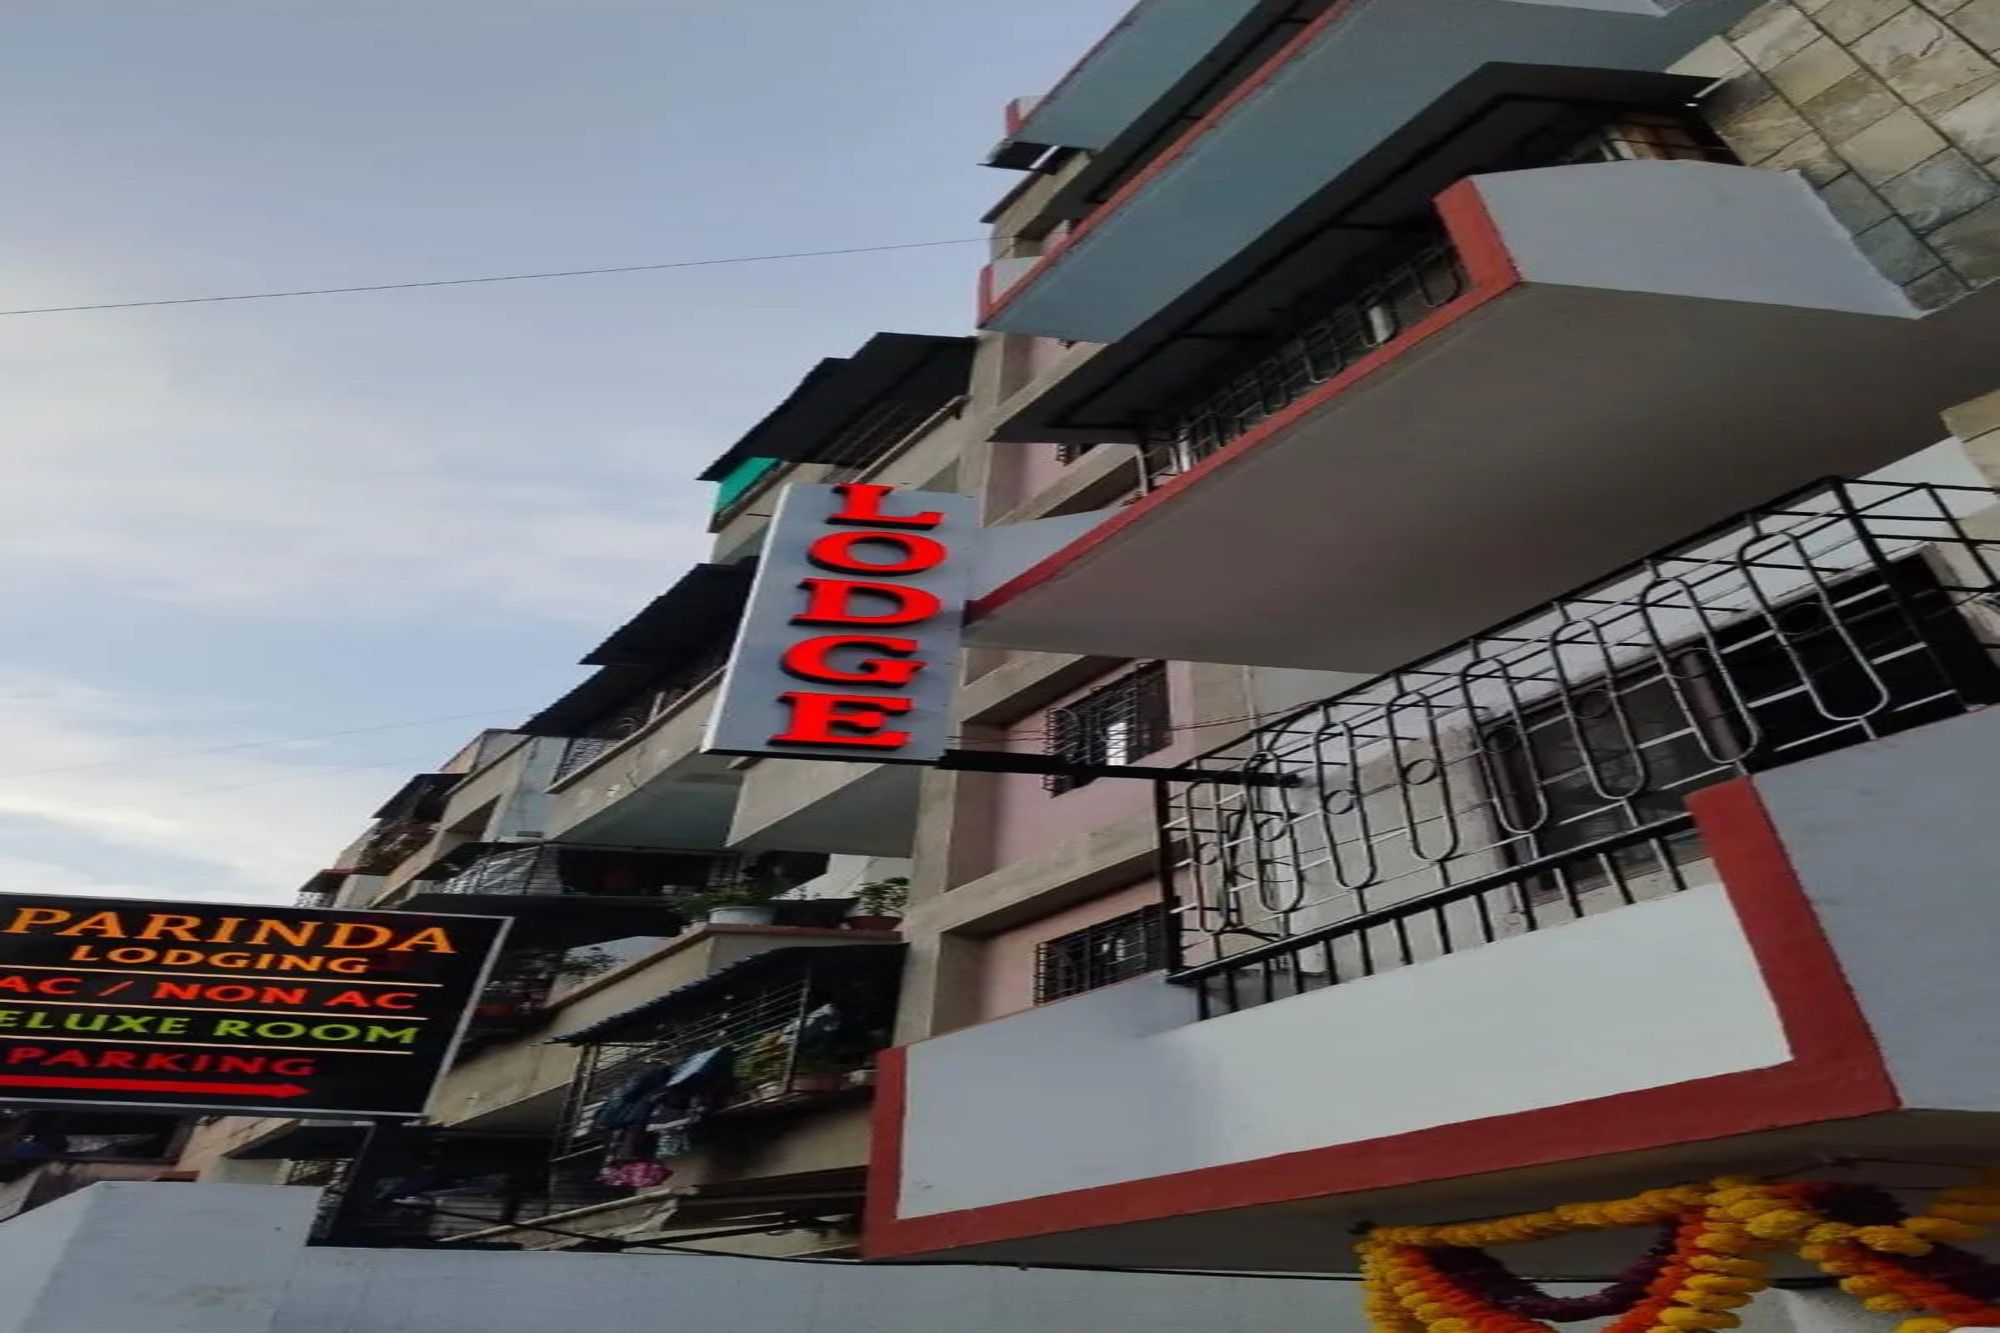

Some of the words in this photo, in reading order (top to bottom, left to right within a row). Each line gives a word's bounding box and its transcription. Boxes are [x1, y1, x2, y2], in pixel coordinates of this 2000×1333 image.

[767, 482, 948, 751] LODGE
[2, 907, 458, 954] PARINDA
[69, 945, 370, 974] LODGING
[0, 975, 83, 996] AC
[152, 981, 306, 1004] NON
[324, 989, 420, 1010] AC
[213, 1018, 422, 1044] ROOM
[7, 1046, 317, 1076] PARKING
